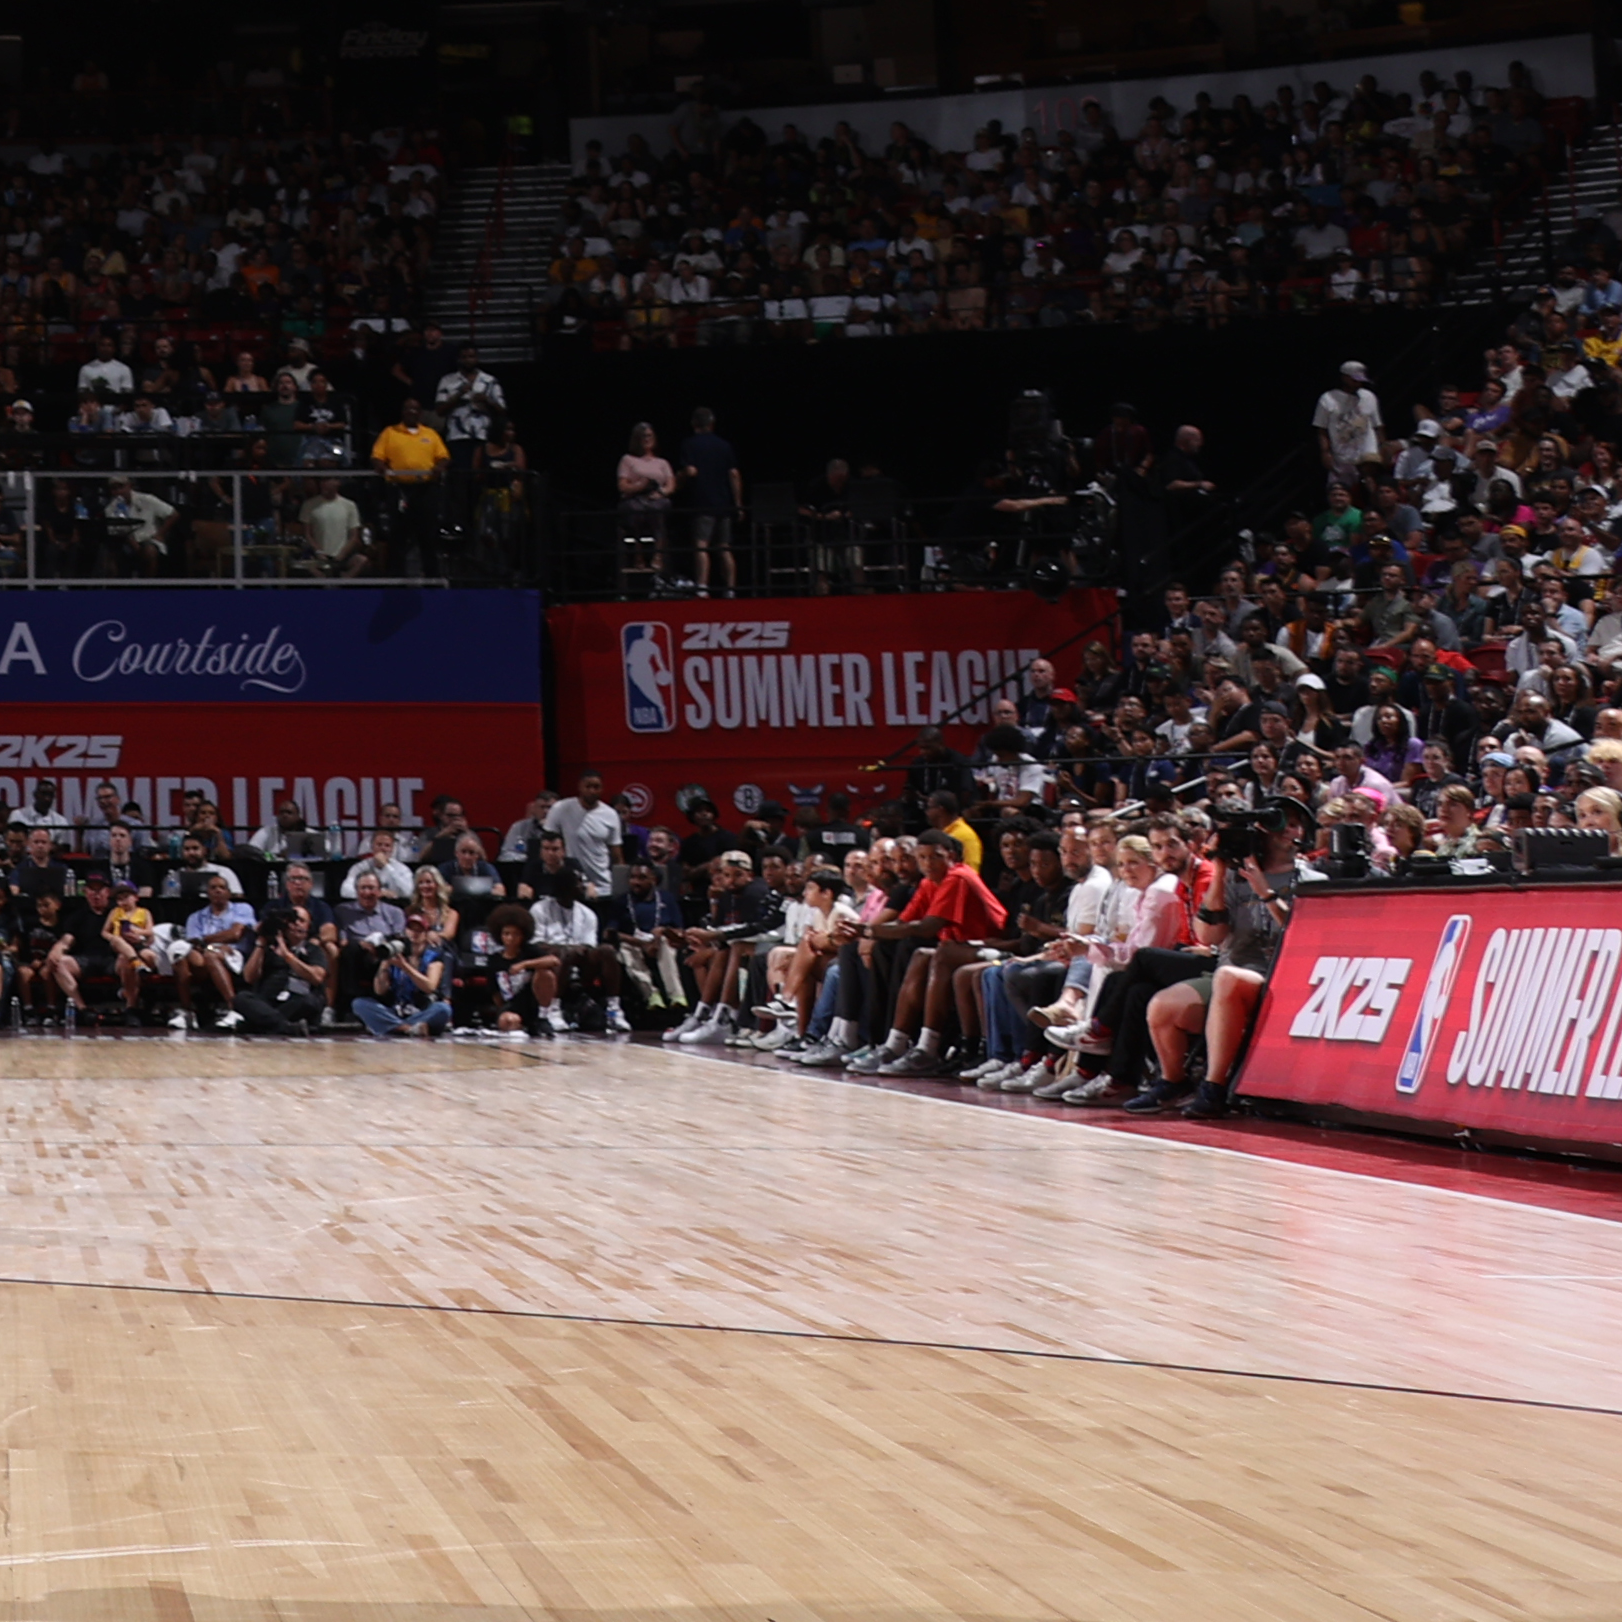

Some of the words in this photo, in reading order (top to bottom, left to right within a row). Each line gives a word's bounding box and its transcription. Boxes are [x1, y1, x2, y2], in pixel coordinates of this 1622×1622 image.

[1032, 95, 1100, 136] 10
[72, 619, 307, 695] Courtside
[681, 620, 791, 650] 2K25
[683, 653, 875, 730] SUMMER
[1289, 956, 1414, 1044] 2K25
[1446, 927, 1622, 1097] SUMMER
